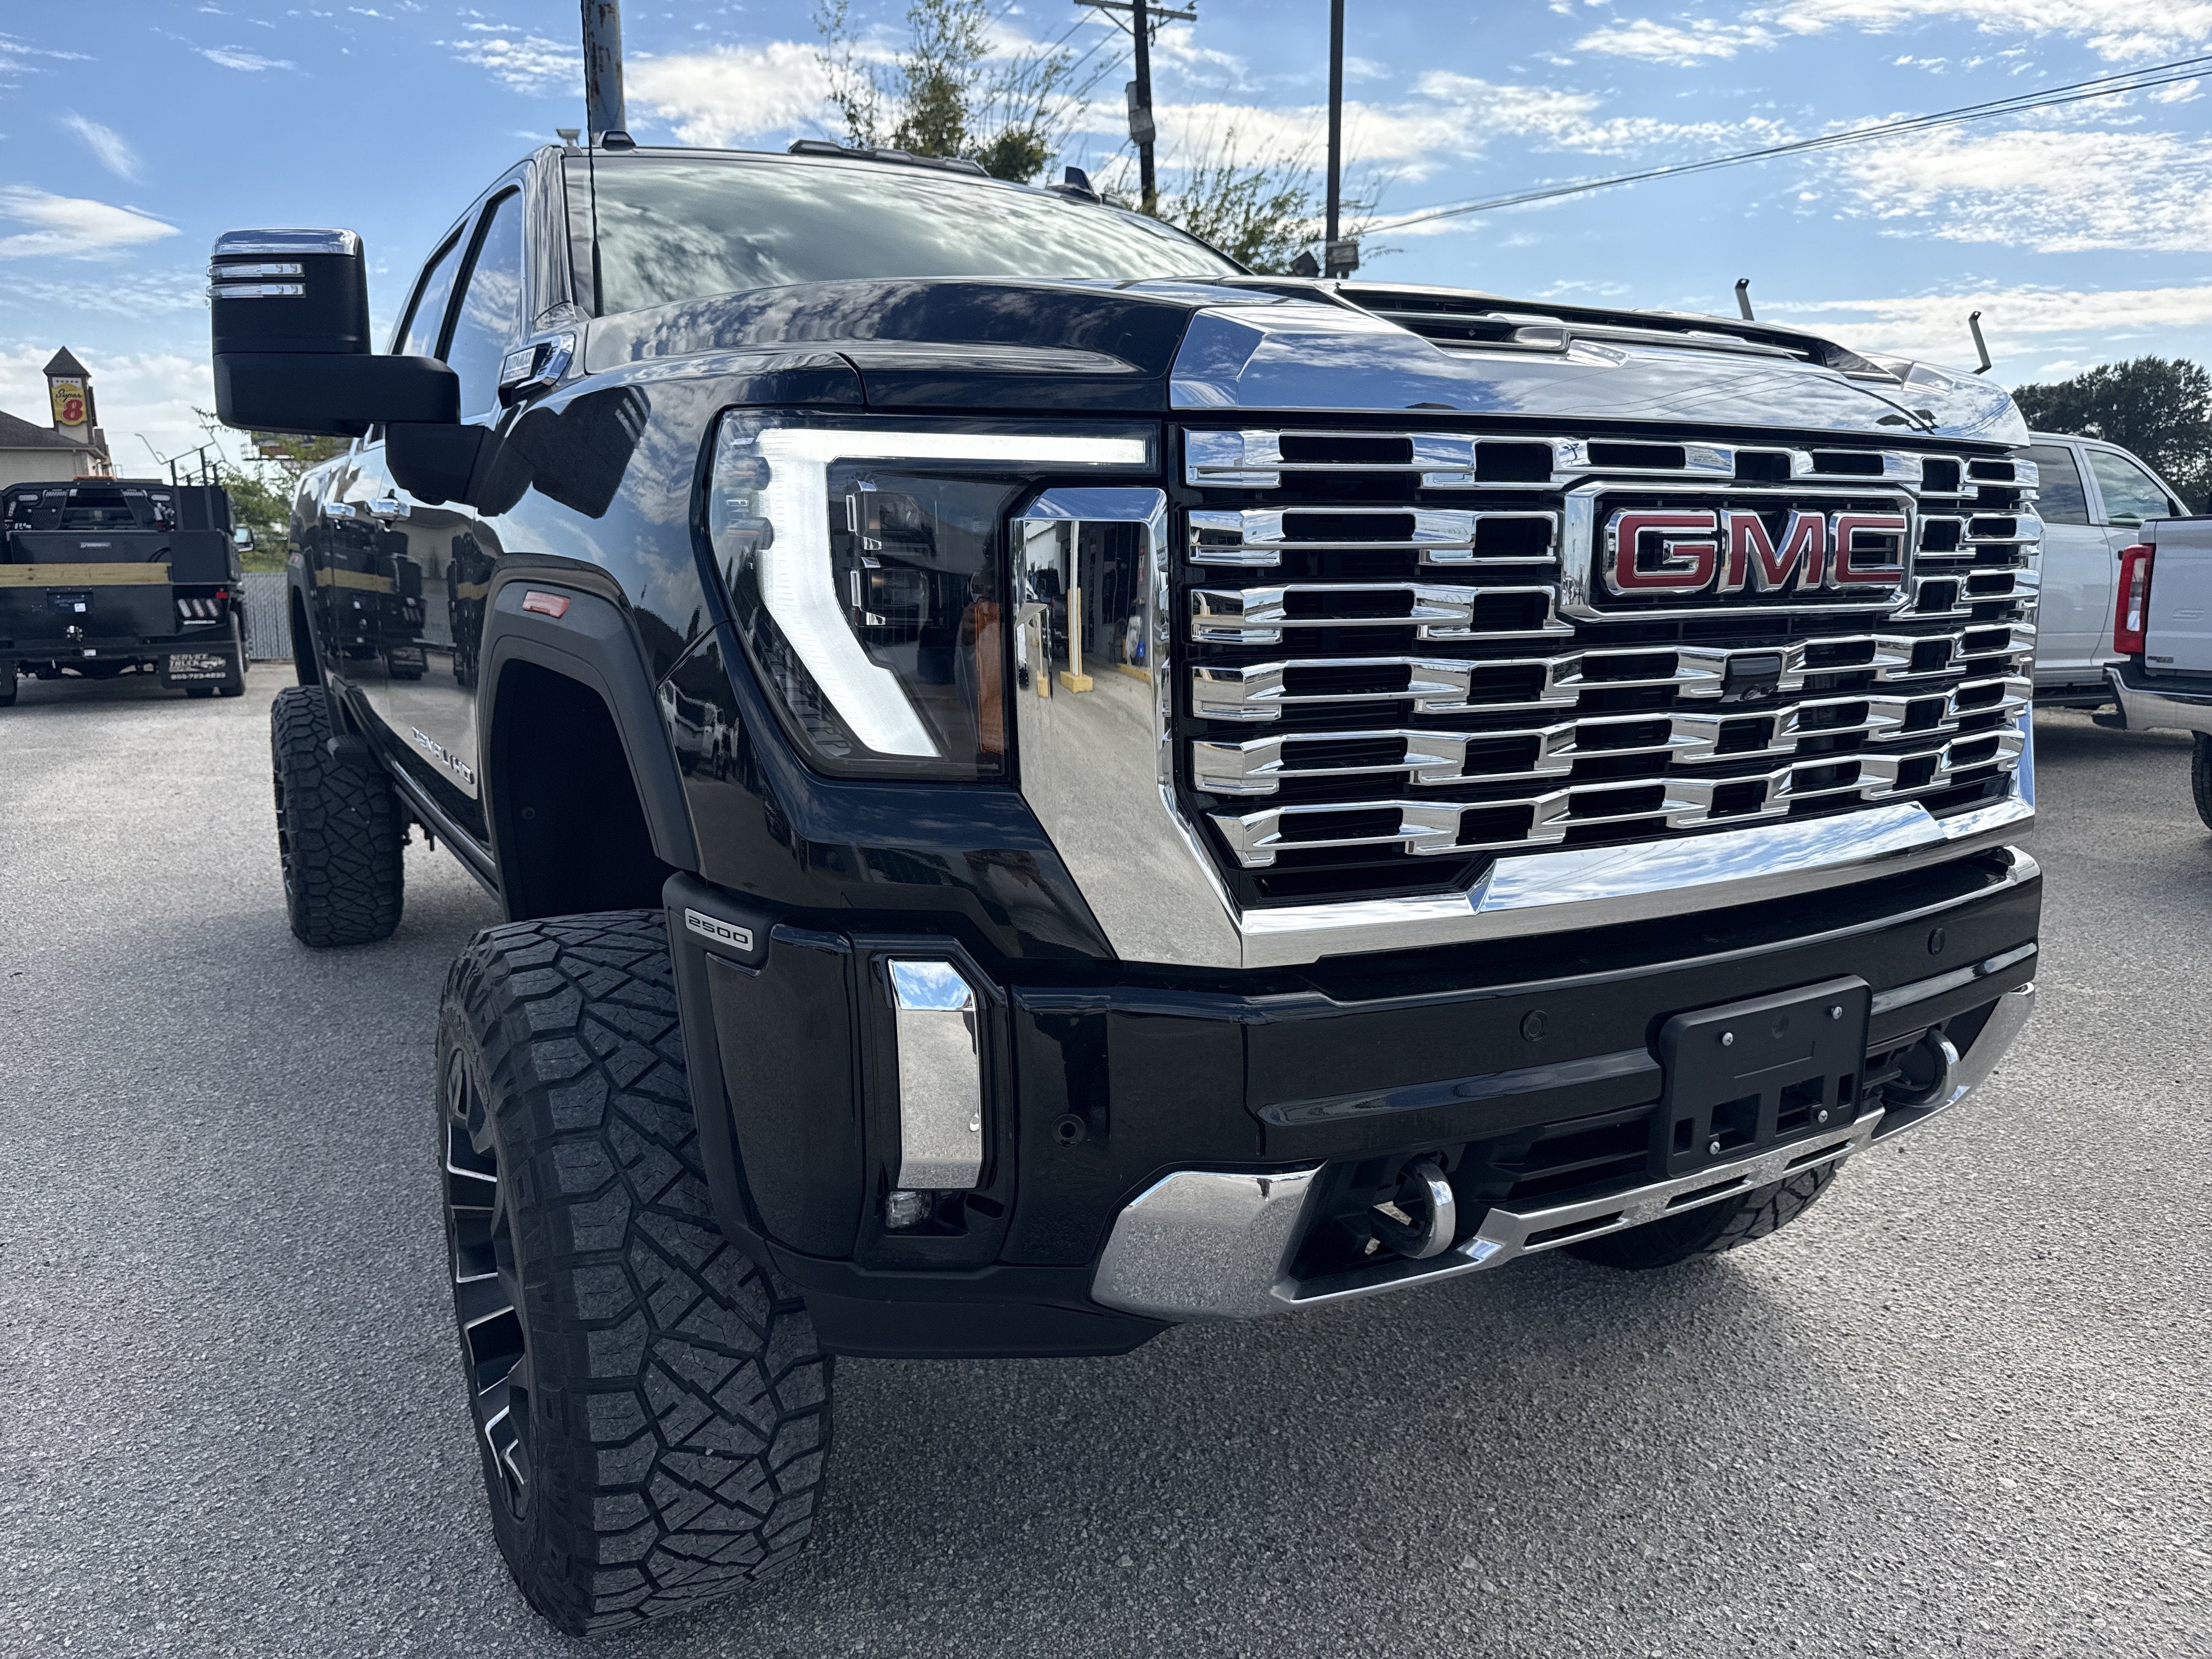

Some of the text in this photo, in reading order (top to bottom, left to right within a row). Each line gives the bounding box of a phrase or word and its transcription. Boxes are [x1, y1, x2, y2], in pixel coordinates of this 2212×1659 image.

[55, 388, 82, 403] Super
[62, 399, 83, 421] 8
[1603, 507, 1908, 596] GMC
[689, 915, 748, 944] 2500
